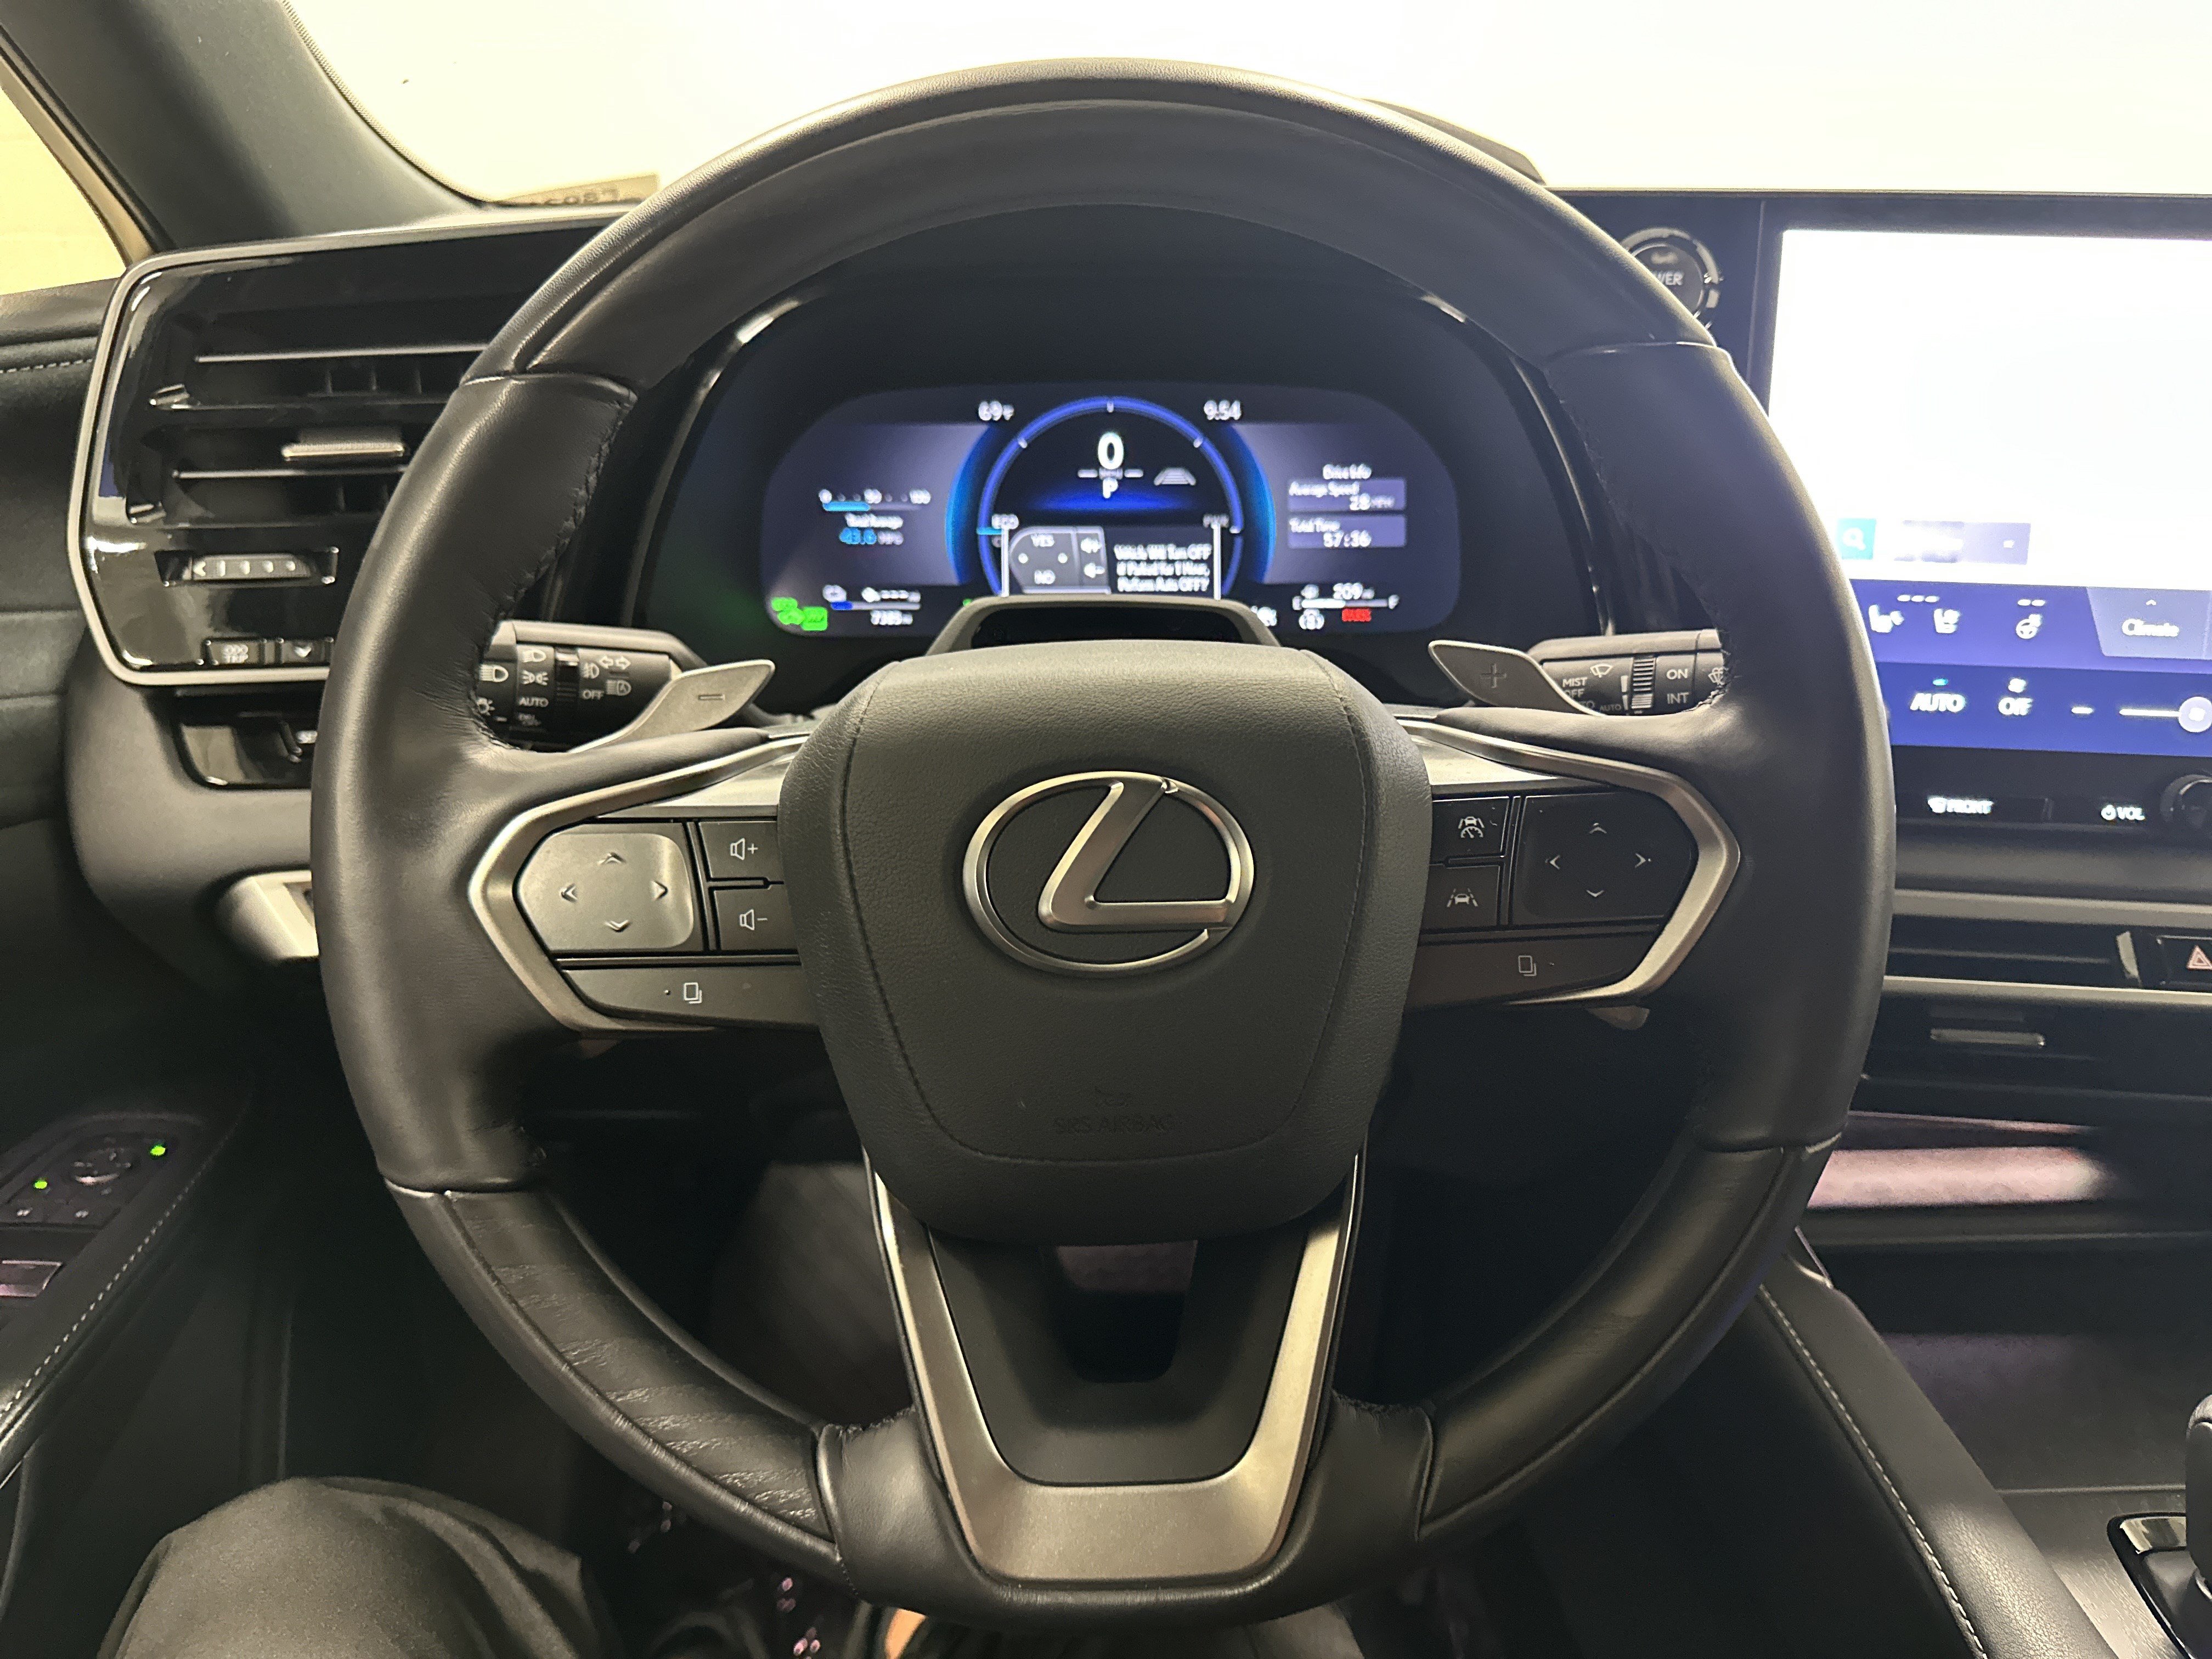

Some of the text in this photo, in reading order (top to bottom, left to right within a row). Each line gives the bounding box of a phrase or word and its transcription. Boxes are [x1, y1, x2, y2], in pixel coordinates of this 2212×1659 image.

[1098, 432, 1124, 470] 0
[1102, 477, 1119, 498] P
[2121, 619, 2180, 637] Climate
[1562, 676, 1588, 688] MIST
[1666, 669, 1688, 680] ON
[519, 697, 549, 707] AUTO
[583, 689, 604, 700] OFF
[1667, 692, 1689, 704] INT
[1910, 693, 1966, 713] AUTO
[1946, 799, 1994, 814] FRONT
[2117, 806, 2146, 821] VOL
